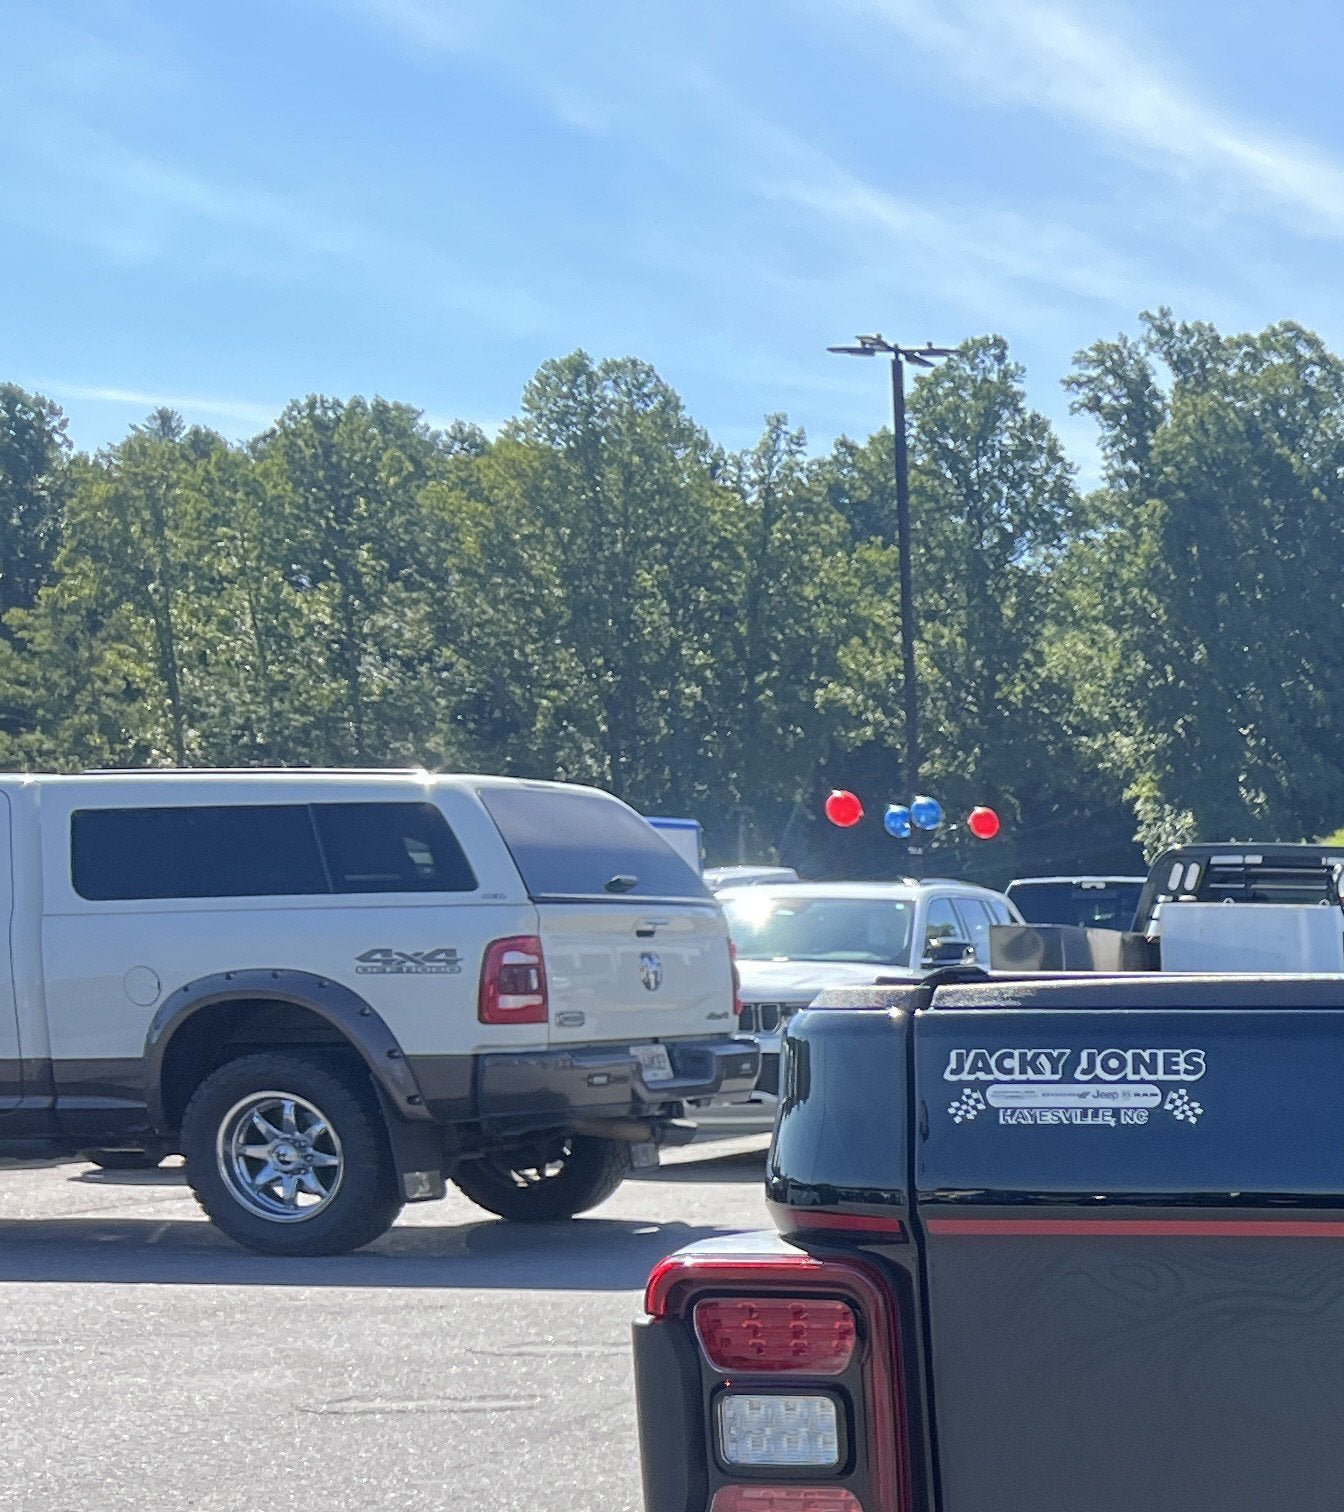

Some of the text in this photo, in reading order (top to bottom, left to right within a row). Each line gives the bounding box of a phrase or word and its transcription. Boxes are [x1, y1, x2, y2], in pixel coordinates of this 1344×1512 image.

[944, 1049, 1206, 1081] JACKY JONES
[1120, 1108, 1150, 1124] NC
